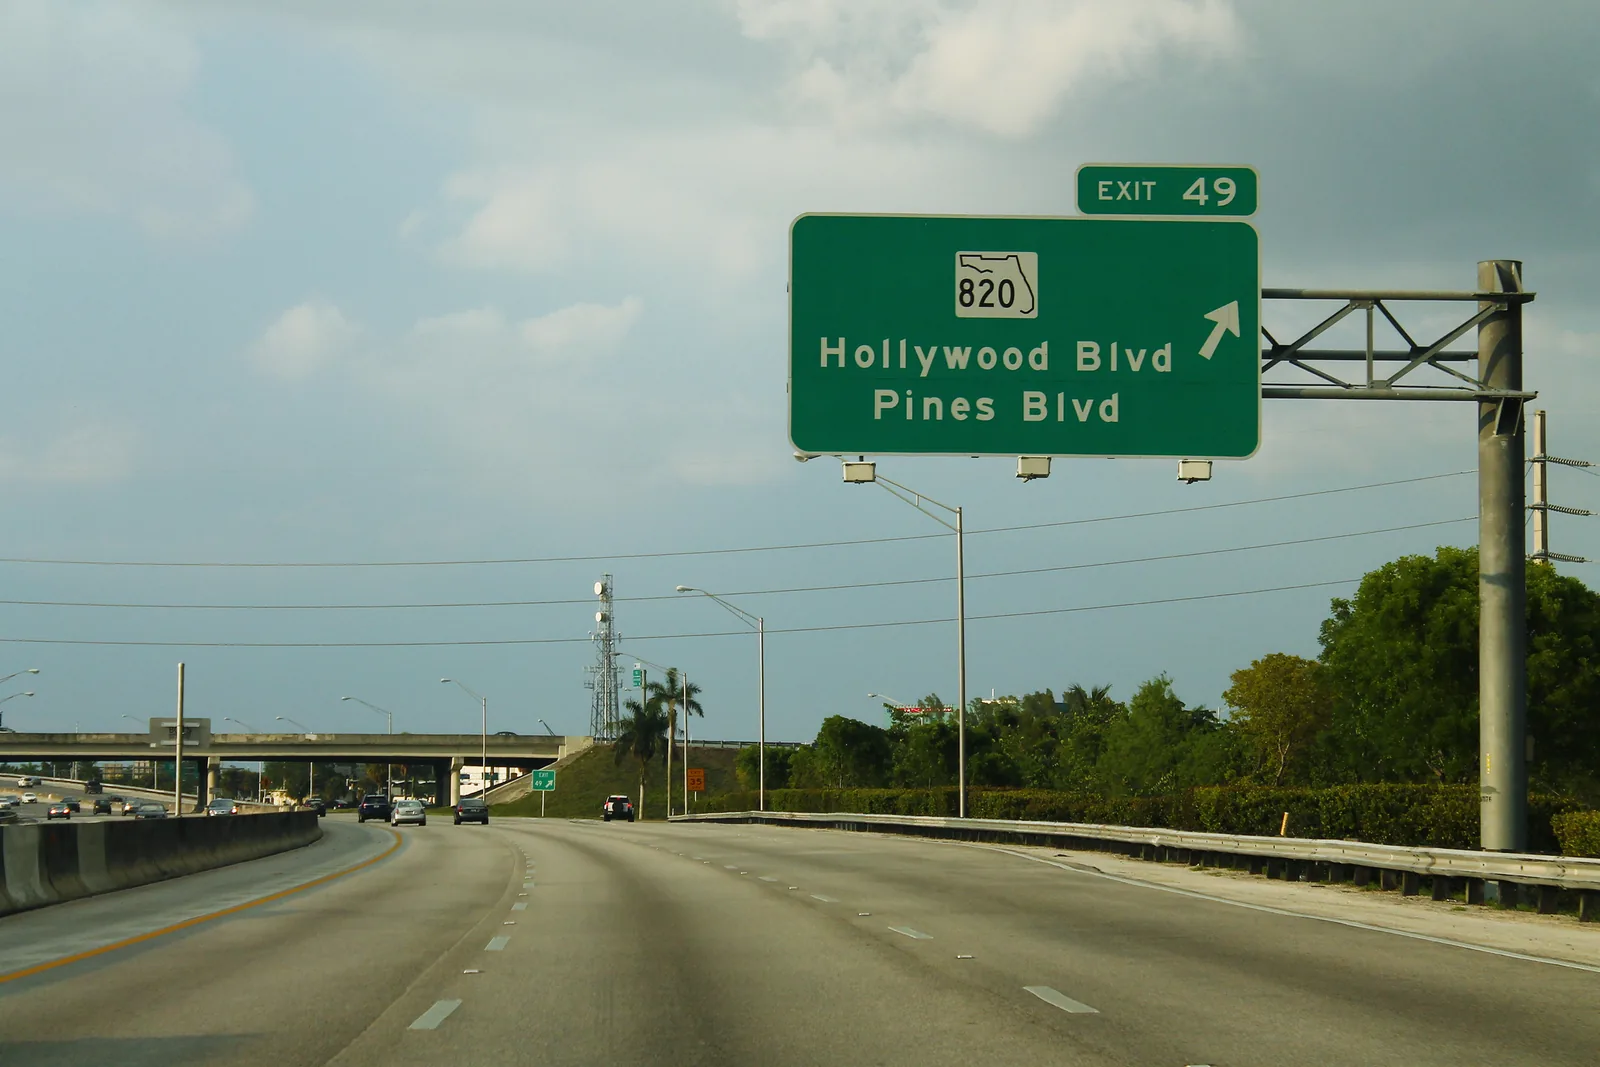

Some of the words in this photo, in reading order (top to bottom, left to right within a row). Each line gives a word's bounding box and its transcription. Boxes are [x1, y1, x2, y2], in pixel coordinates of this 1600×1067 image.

[1098, 181, 1157, 201] EXIT
[1182, 177, 1237, 207] 49
[958, 278, 1016, 309] 820
[820, 336, 1049, 378] Hollywood
[1076, 341, 1173, 373] Blvd
[874, 389, 996, 421] Pines
[1023, 391, 1120, 423] Blvd
[690, 778, 702, 786] 35
